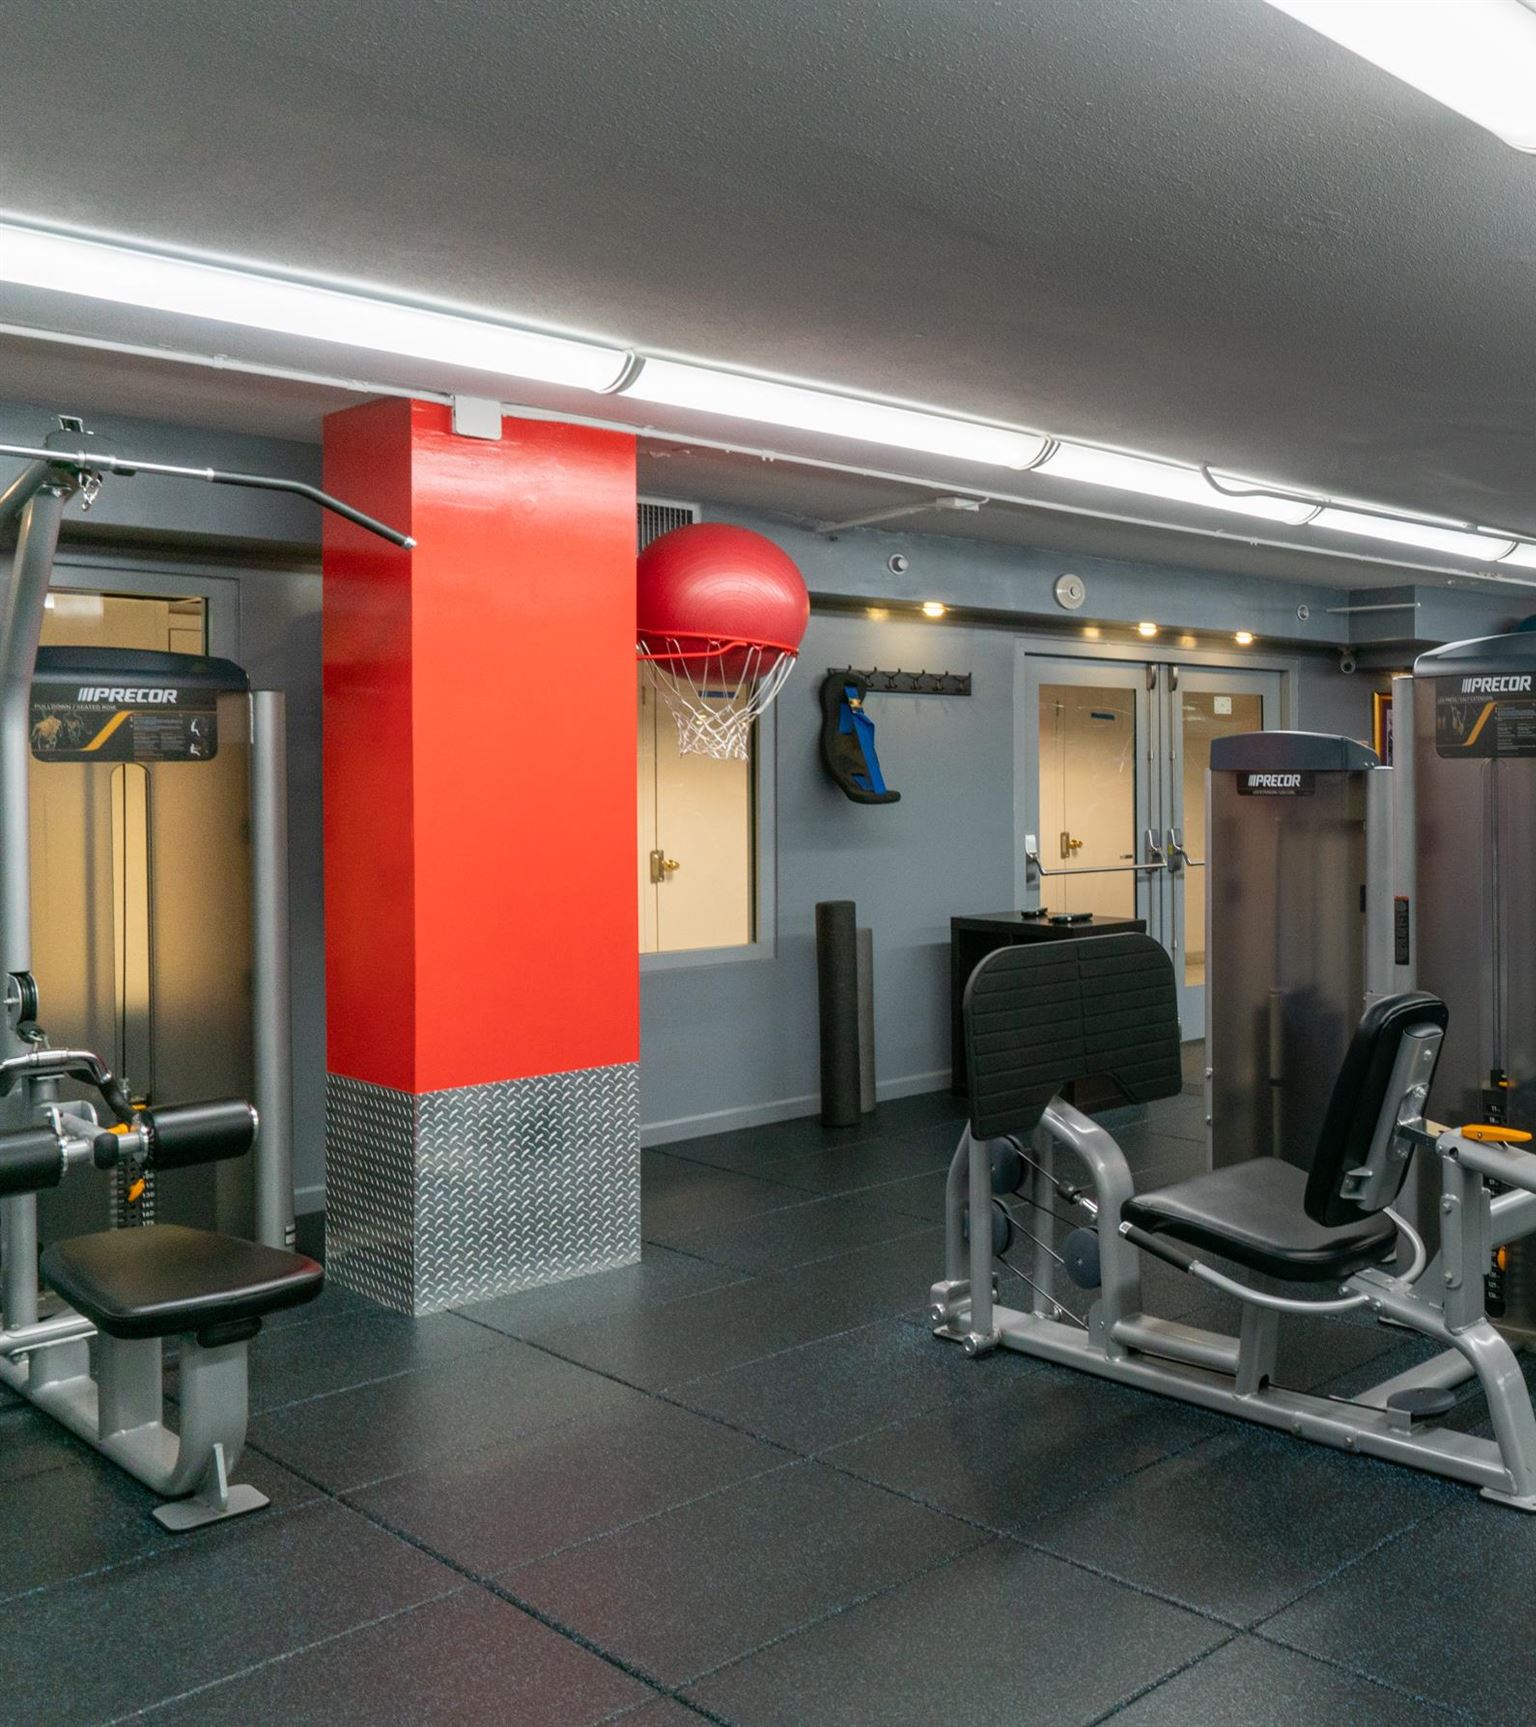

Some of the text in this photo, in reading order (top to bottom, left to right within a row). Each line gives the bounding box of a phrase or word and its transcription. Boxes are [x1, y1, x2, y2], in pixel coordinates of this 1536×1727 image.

[1471, 675, 1532, 693] PRECOR
[93, 687, 178, 704] PRECOR
[1255, 774, 1301, 787] PRECOR
